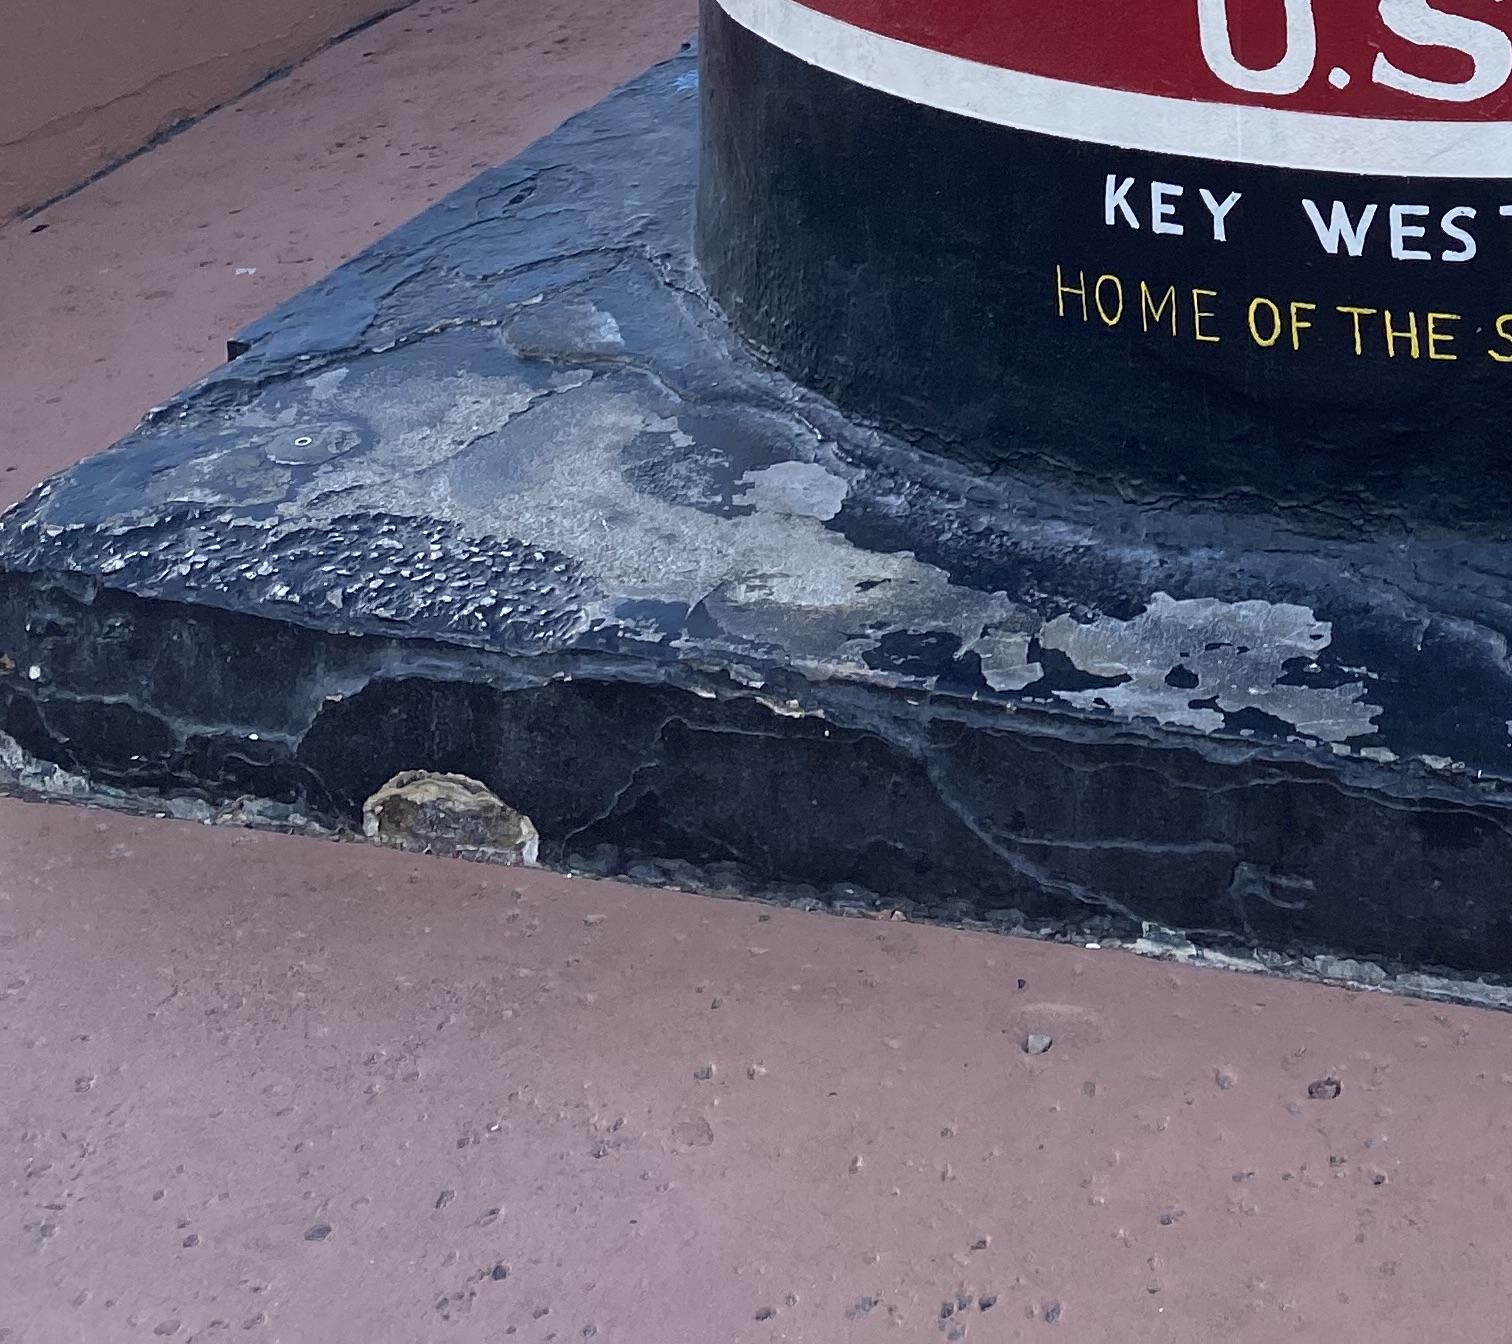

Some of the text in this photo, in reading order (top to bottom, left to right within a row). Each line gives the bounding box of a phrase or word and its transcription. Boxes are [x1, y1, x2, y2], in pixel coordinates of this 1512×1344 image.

[1105, 173, 1242, 242] KEY
[1054, 264, 1221, 343] HOME
[1248, 297, 1316, 351] OF
[1337, 305, 1461, 362] THE
